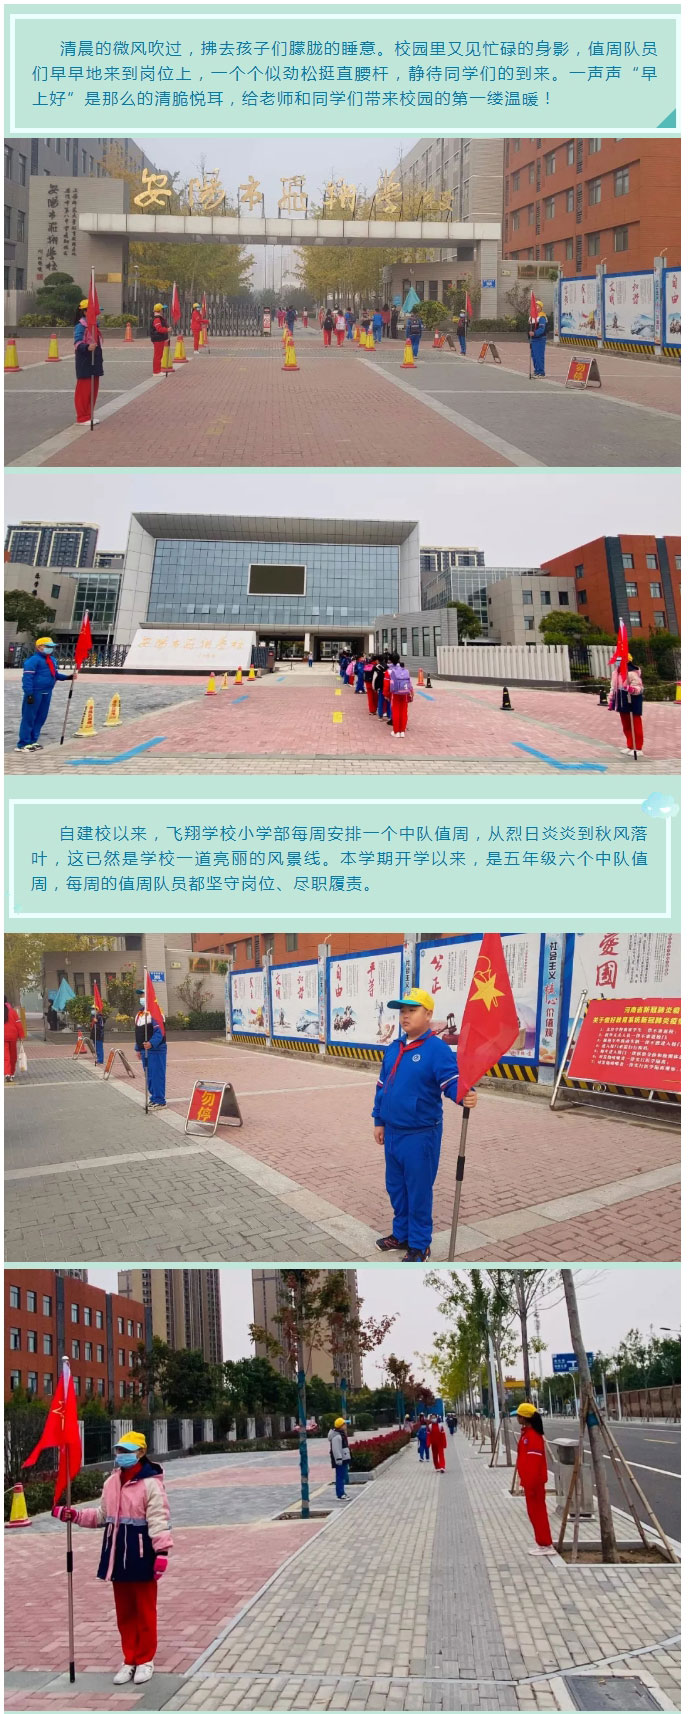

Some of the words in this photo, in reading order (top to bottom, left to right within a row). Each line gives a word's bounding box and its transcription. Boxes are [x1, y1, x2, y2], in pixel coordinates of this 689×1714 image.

[574, 363, 586, 381] 勿停
[335, 963, 343, 998] 自由
[367, 962, 376, 997] 平等
[430, 954, 444, 995] 公正
[197, 1091, 216, 1122] 勿停
